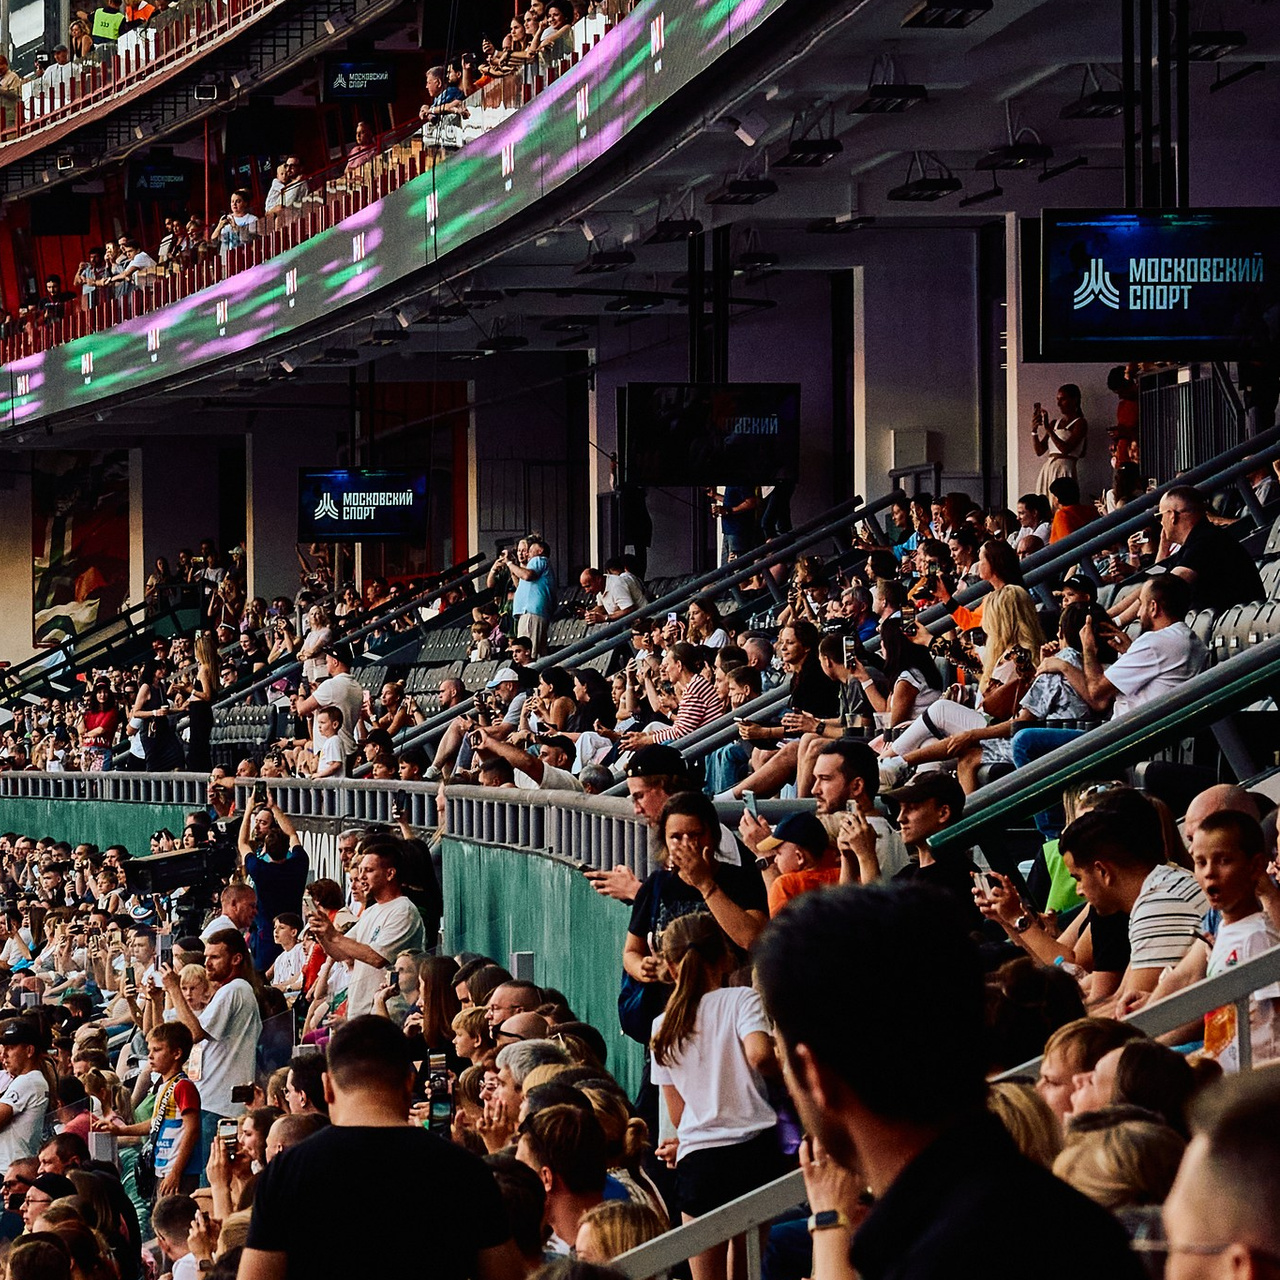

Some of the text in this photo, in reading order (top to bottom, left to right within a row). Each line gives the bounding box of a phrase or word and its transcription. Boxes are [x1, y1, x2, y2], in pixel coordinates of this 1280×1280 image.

[349, 71, 388, 80] МОСКОВСКИЙ
[1129, 252, 1264, 282] МОСКОВСКИЙ
[1129, 285, 1192, 310] СПОРТ
[343, 489, 413, 505] МОСКОВСКИЙ
[343, 506, 376, 520] СПОРТ
